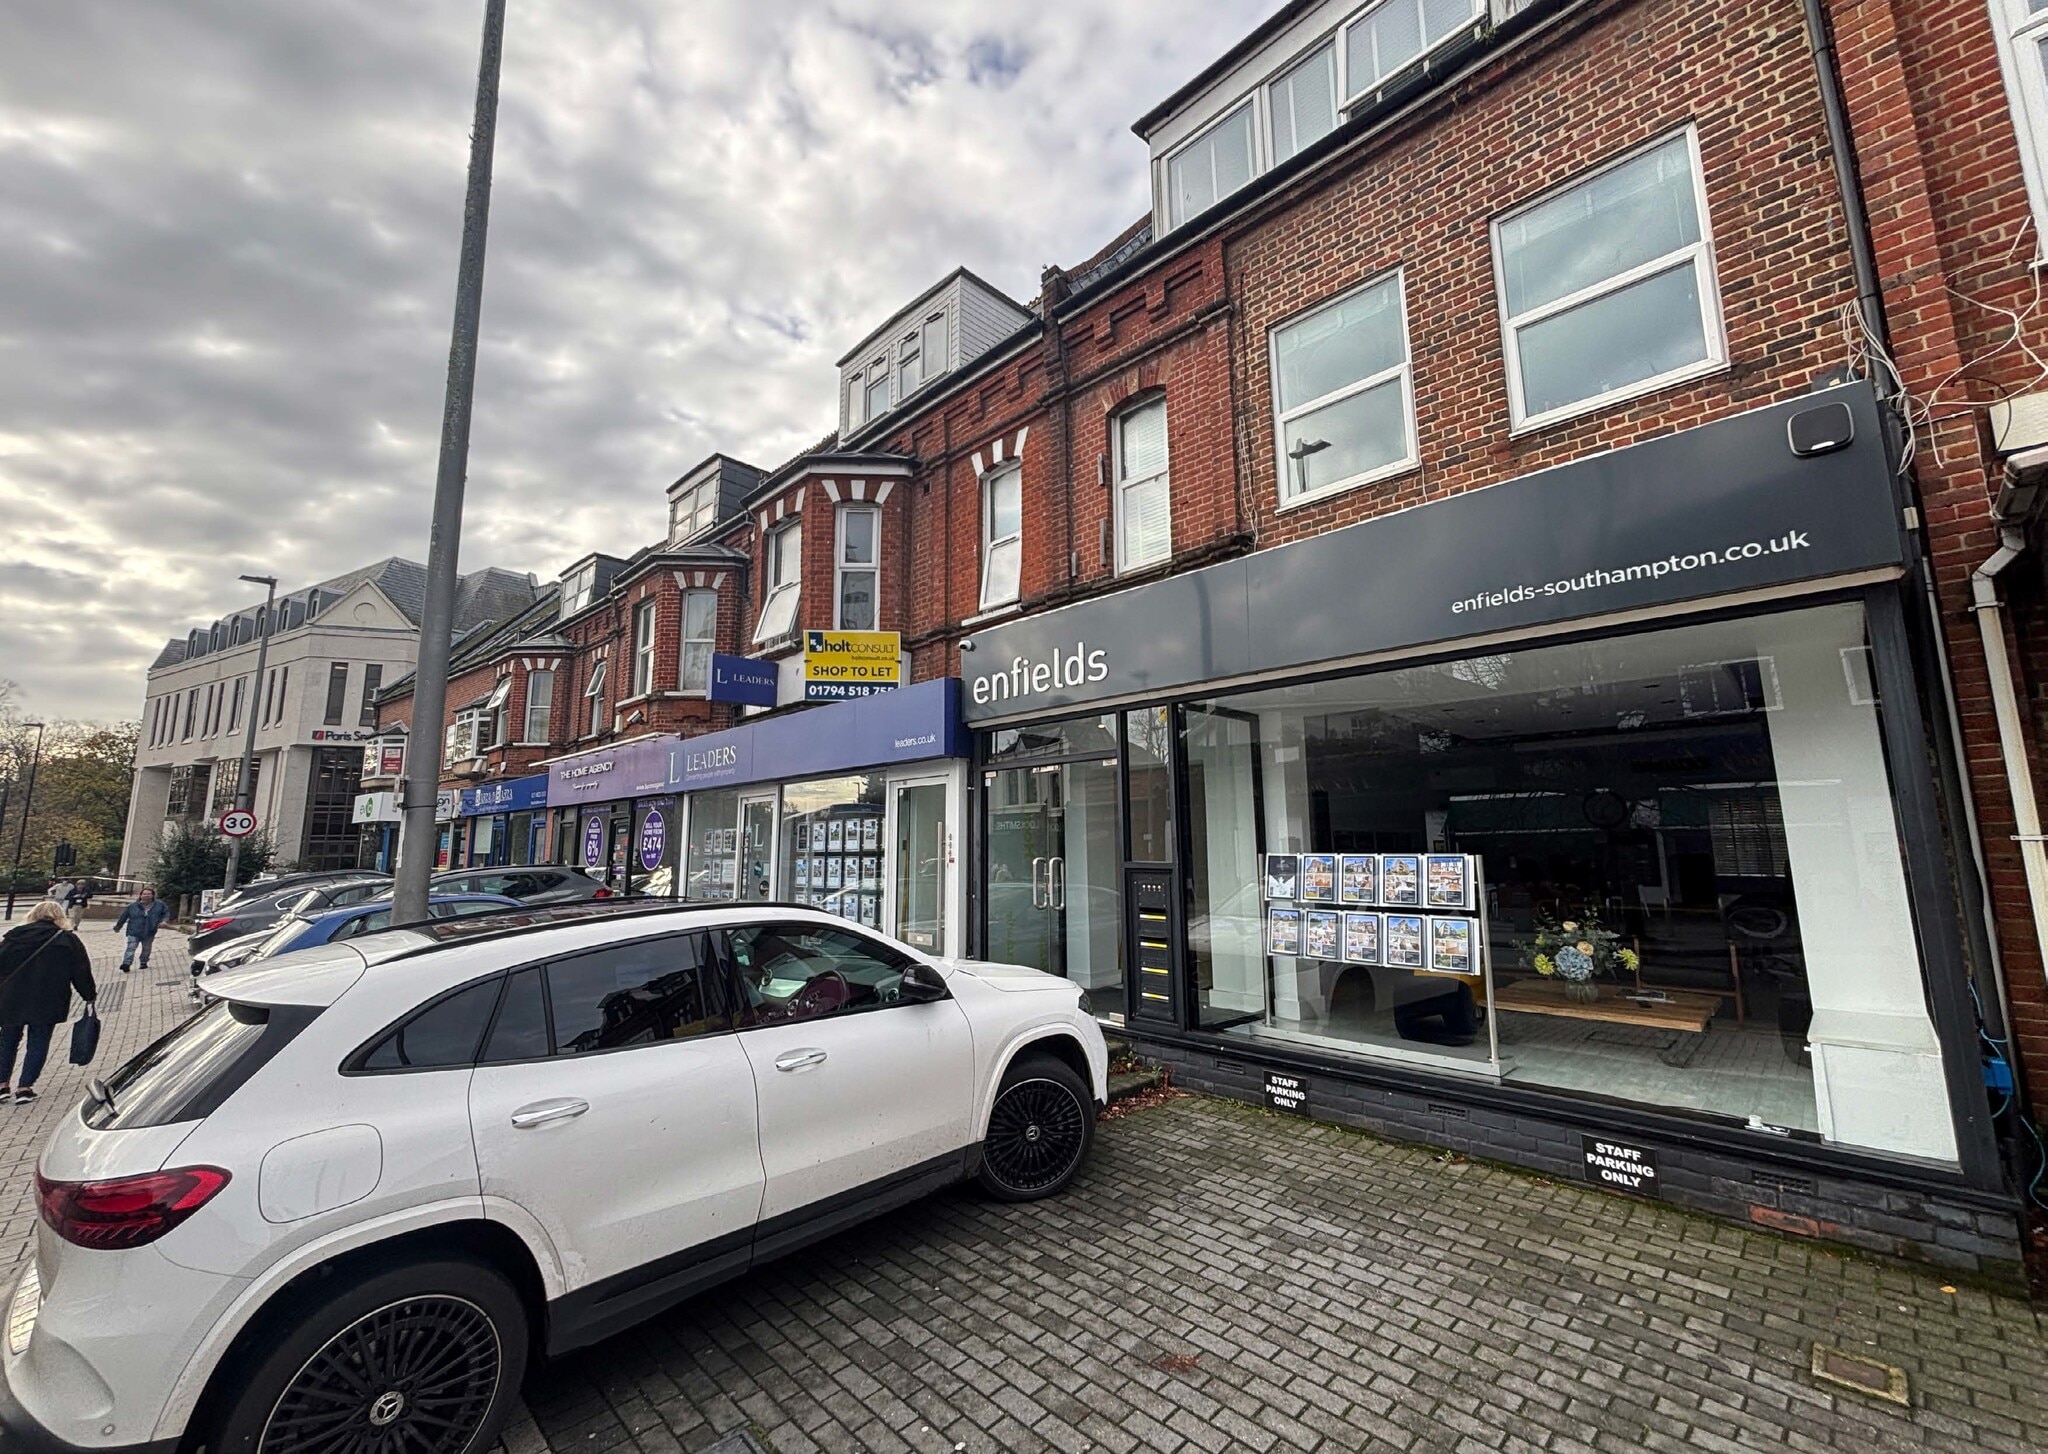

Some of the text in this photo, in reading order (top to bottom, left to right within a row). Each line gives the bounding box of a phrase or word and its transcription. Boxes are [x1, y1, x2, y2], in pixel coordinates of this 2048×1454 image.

[1451, 529, 1810, 614] enfields-southampton.co.uk
[824, 639, 895, 653] holtCONSULT
[813, 666, 892, 676] SHOP TO LET
[973, 641, 1108, 704] enfields
[733, 673, 775, 686] LEADERS
[809, 685, 845, 696] 01794
[848, 686, 870, 696] 518
[325, 730, 352, 741] Paris
[894, 733, 936, 748] leaders.co.uk
[686, 745, 737, 772] LEADERS
[560, 761, 615, 780] THE HOME AGENCY
[226, 817, 252, 829] 30
[587, 840, 599, 857] 6%
[643, 836, 662, 851] £474
[1271, 1076, 1298, 1089] STAFF
[1265, 1084, 1306, 1100] PARKING
[1273, 1096, 1298, 1109] ONLY
[1595, 1142, 1642, 1161] STAFF
[1586, 1152, 1655, 1178] PARKING
[1601, 1169, 1642, 1188] ONLY
